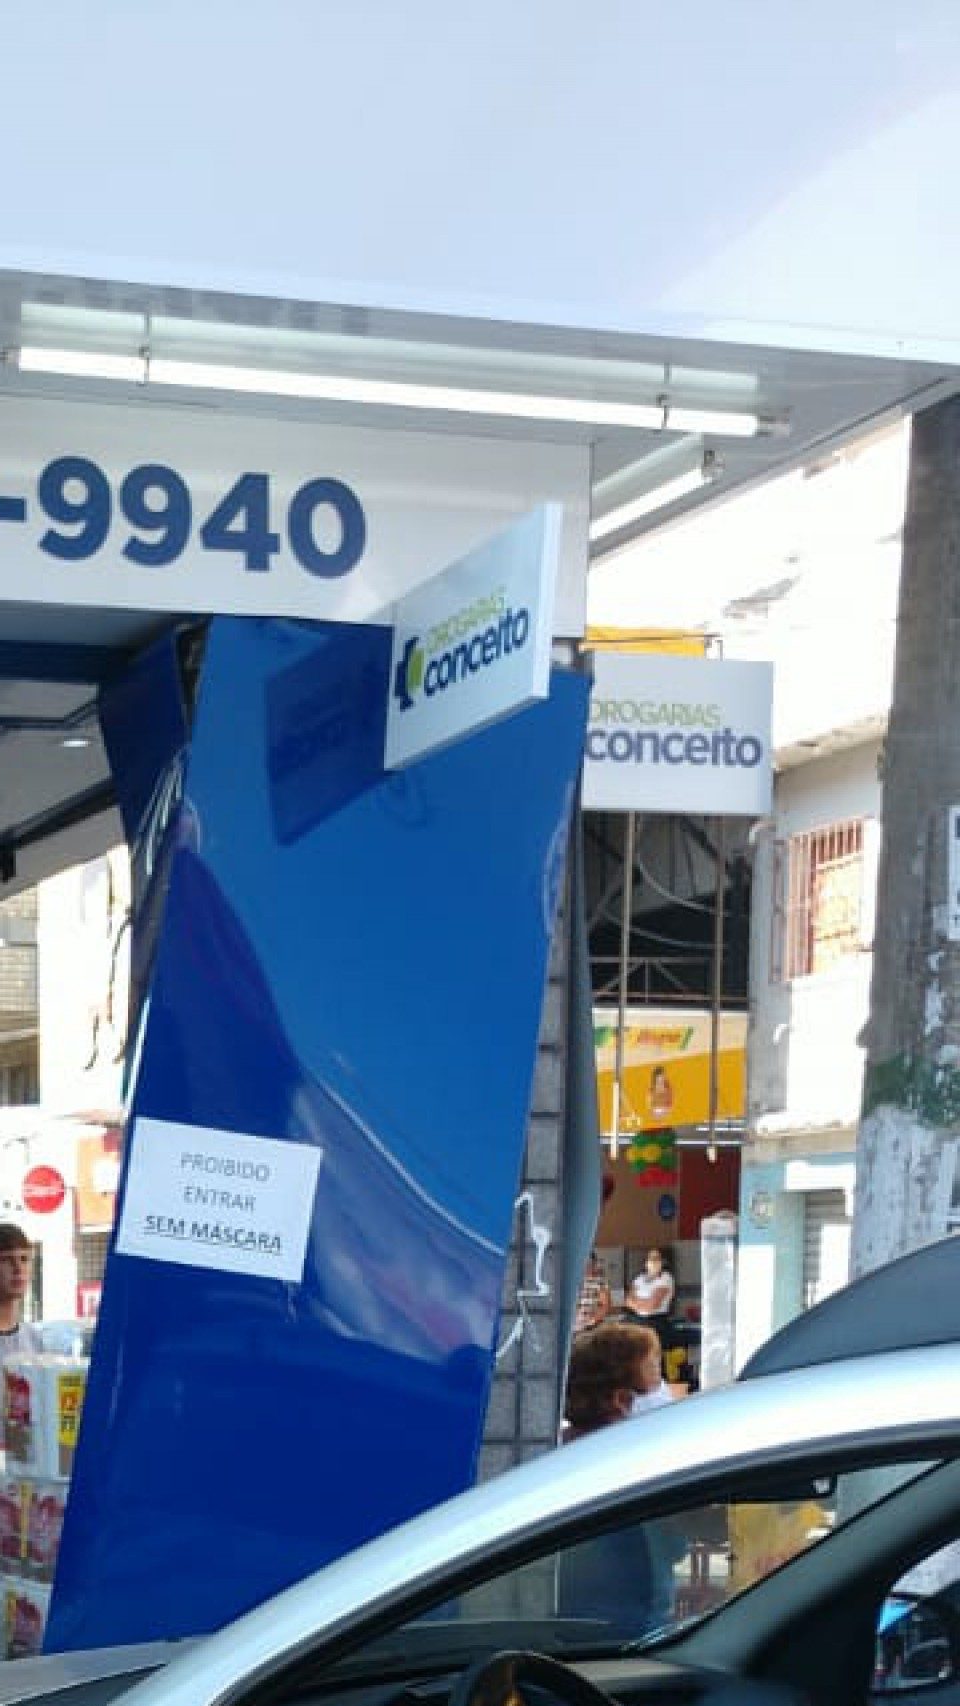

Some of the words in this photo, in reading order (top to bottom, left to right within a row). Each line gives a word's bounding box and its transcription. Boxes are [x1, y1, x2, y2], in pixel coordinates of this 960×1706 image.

[424, 607, 529, 697] conceito
[588, 728, 762, 767] conceito
[180, 1152, 270, 1181] PROIBIDO
[183, 1185, 256, 1211] ENTRAR
[145, 1215, 185, 1235] SEM
